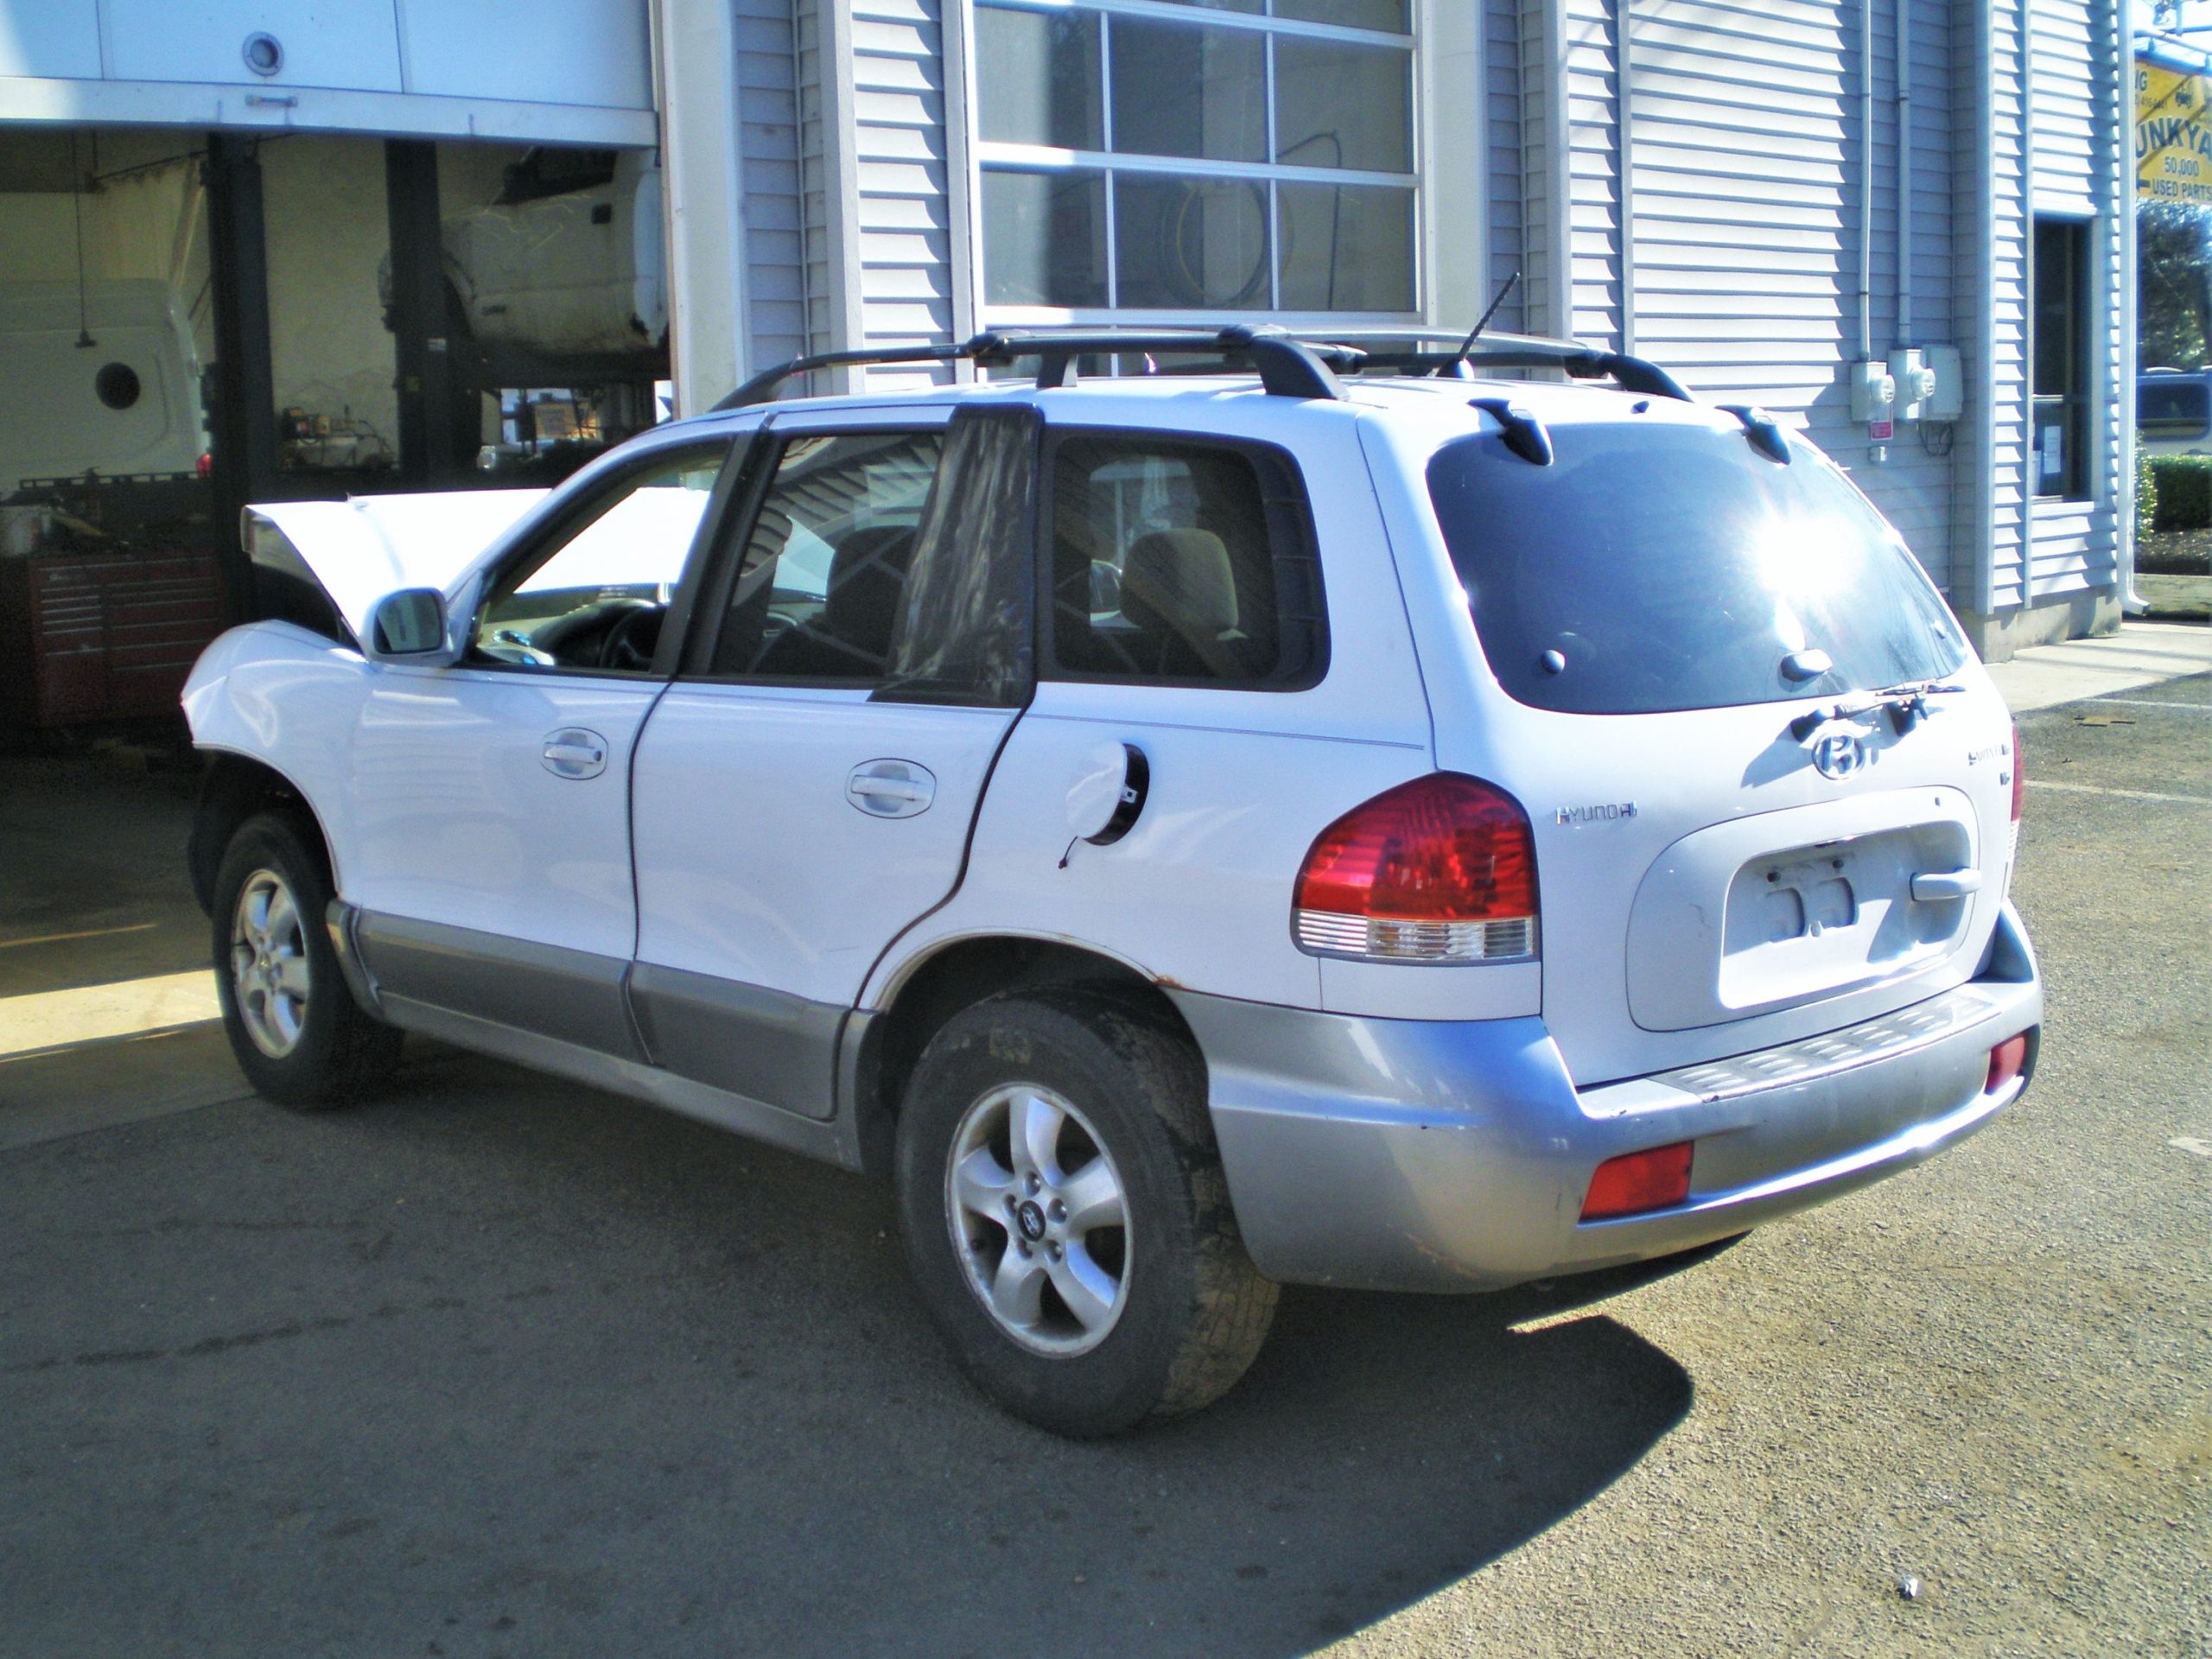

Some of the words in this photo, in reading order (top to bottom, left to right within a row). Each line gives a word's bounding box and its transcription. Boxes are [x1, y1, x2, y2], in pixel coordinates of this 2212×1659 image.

[2164, 156, 2199, 177] 50,000
[2152, 179, 2178, 197] USED
[2182, 182, 2212, 201] PARTS
[1555, 800, 1637, 824] HYUNDAI
